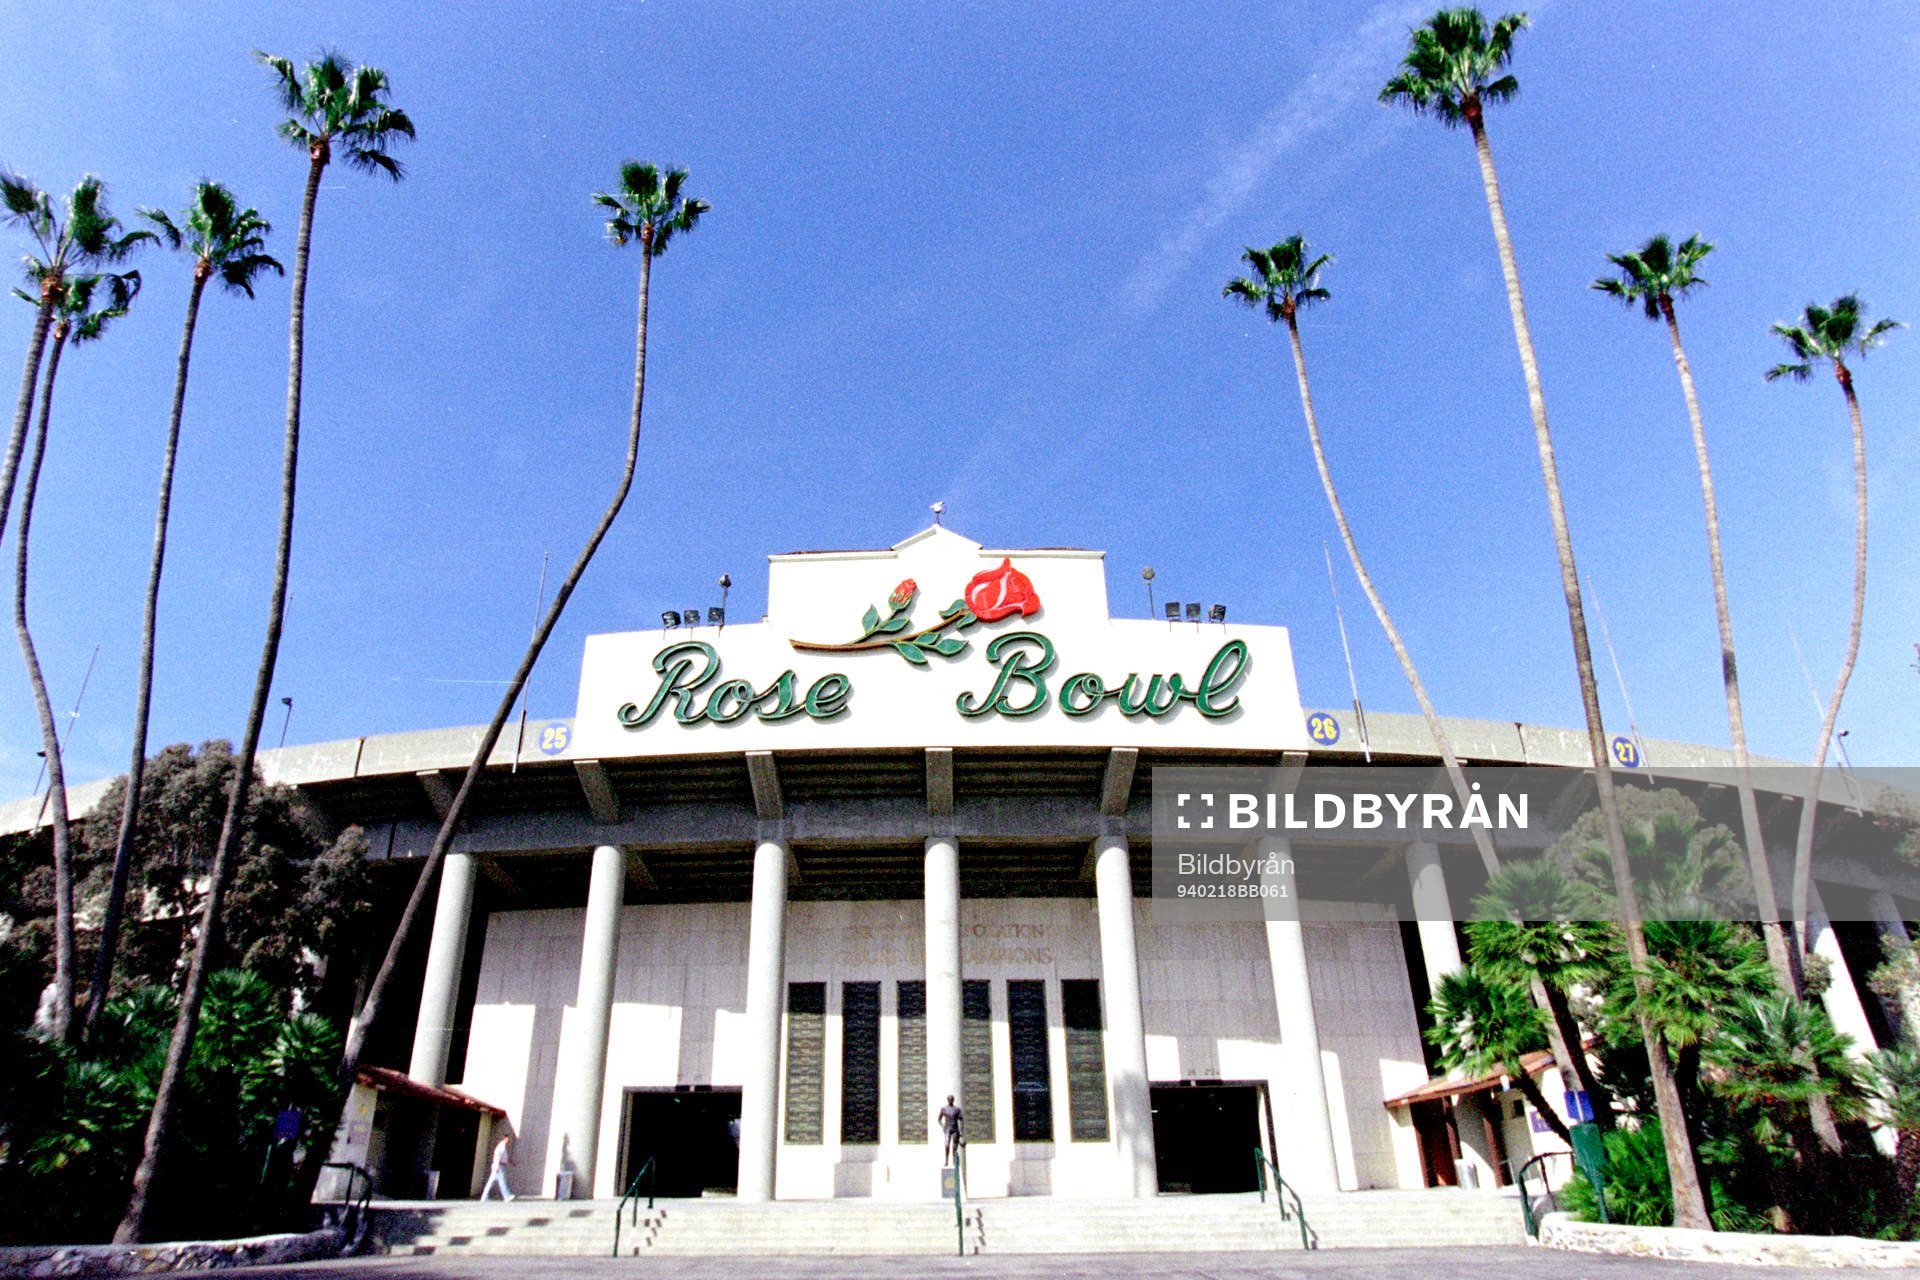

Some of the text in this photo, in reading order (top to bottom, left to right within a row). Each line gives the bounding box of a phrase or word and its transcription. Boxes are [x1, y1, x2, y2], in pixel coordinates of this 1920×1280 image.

[618, 630, 1250, 726] Rose Bowl
[542, 727, 567, 749] 25
[1311, 717, 1336, 740] 26
[1615, 741, 1635, 763] 27
